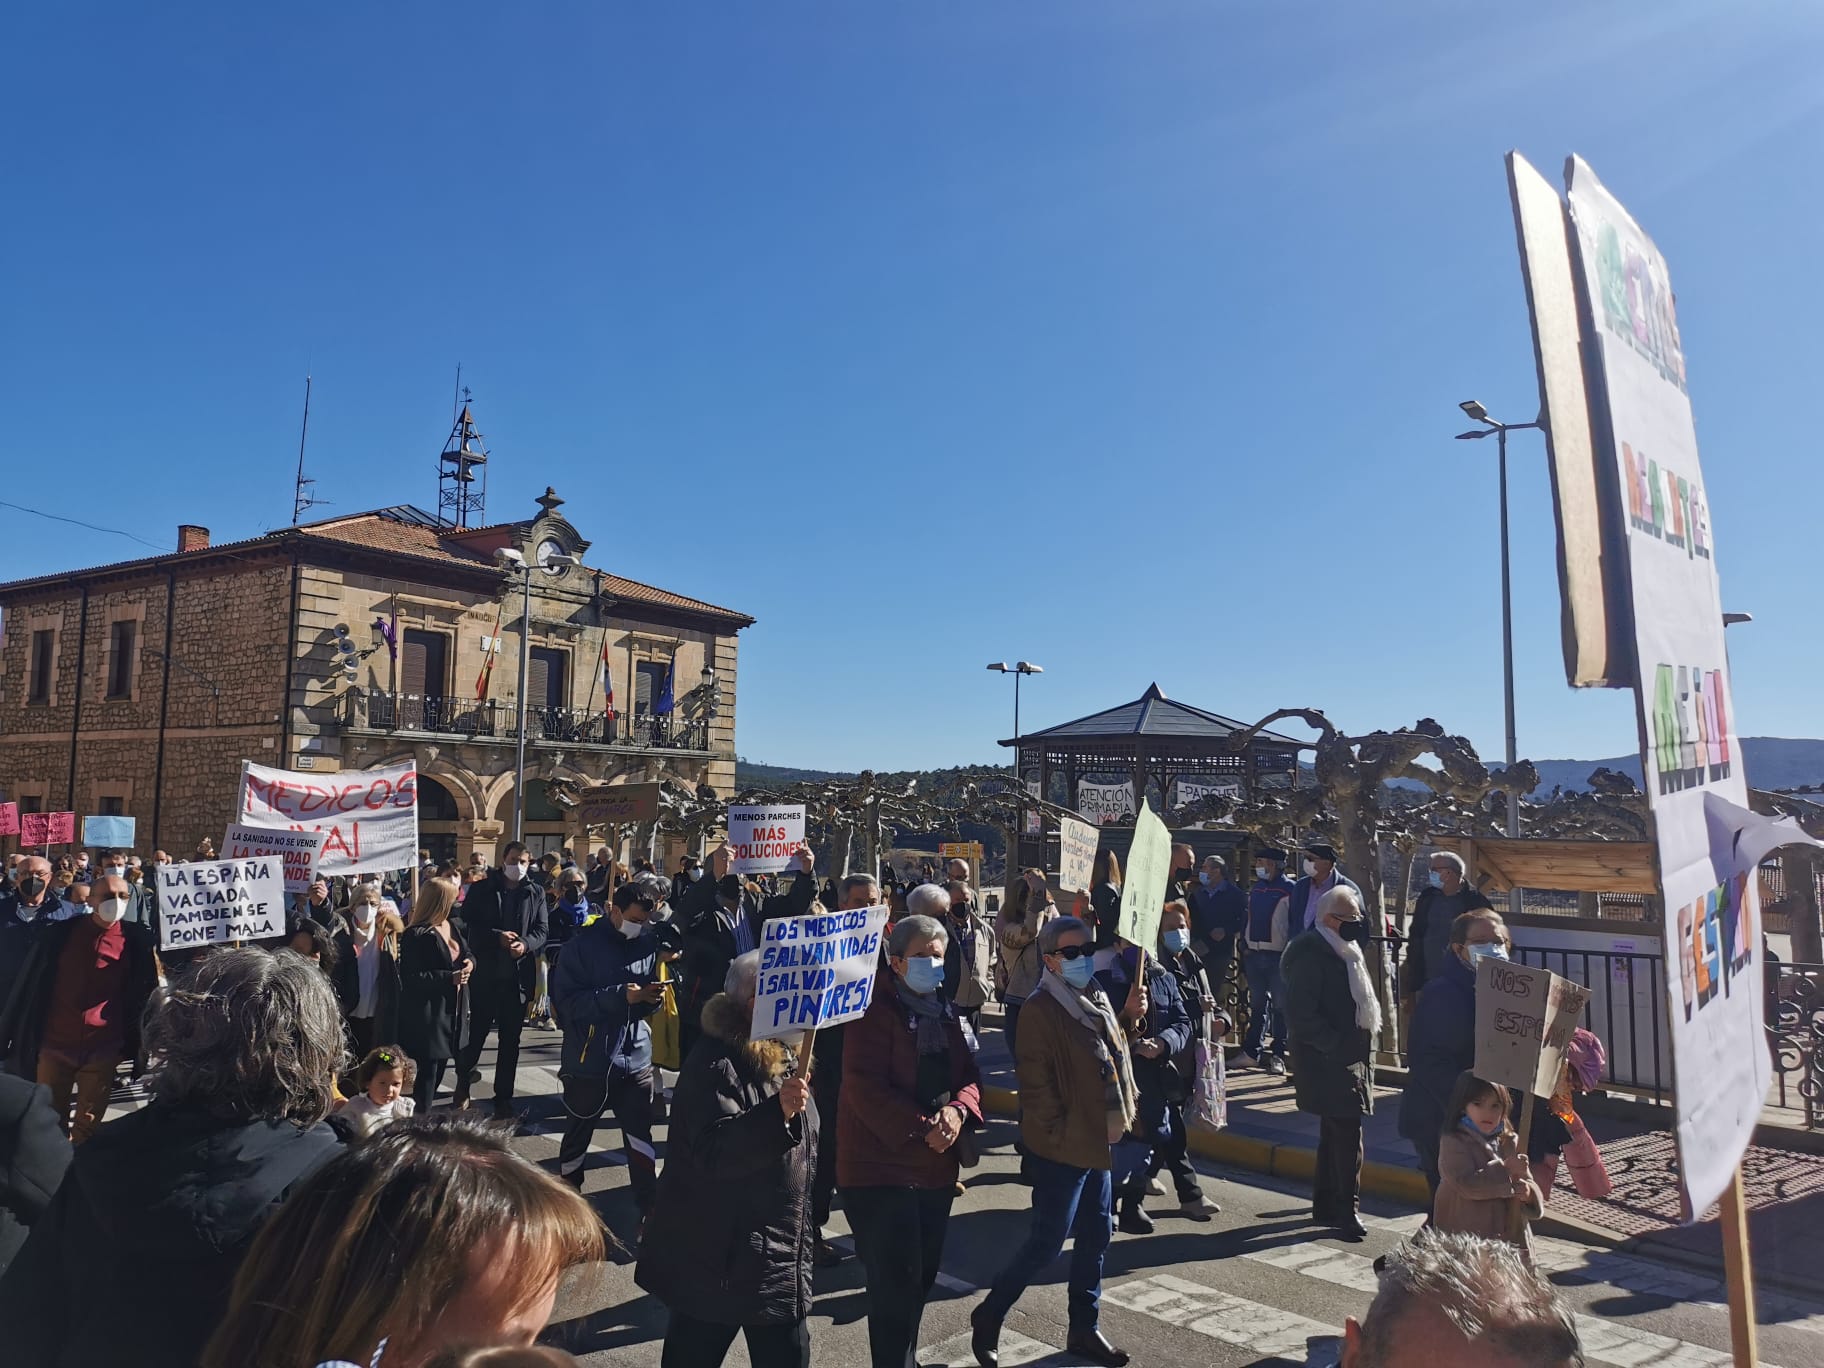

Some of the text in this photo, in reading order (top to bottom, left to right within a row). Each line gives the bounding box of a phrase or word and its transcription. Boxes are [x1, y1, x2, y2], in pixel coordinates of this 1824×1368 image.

[246, 770, 417, 814] MEDICOS
[1079, 784, 1133, 802] ATENCIÓN
[734, 812, 801, 821] MENOS PARCHES
[1080, 799, 1132, 814] PRIMARIA
[232, 832, 318, 848] LA SANIDAD NO SE VENDE
[752, 824, 786, 842] MÁS
[232, 845, 249, 858] LA
[731, 841, 801, 860] SOLUCIONES
[166, 861, 270, 887] LA ESPAÑA
[167, 887, 250, 909] VACIADA
[165, 902, 268, 925] TAMBIEN SE
[170, 919, 274, 944] PONE MALA
[765, 909, 868, 942] LOS MEDICOS
[761, 932, 878, 970] SALVAN VIDAS
[1490, 966, 1534, 998] NOS
